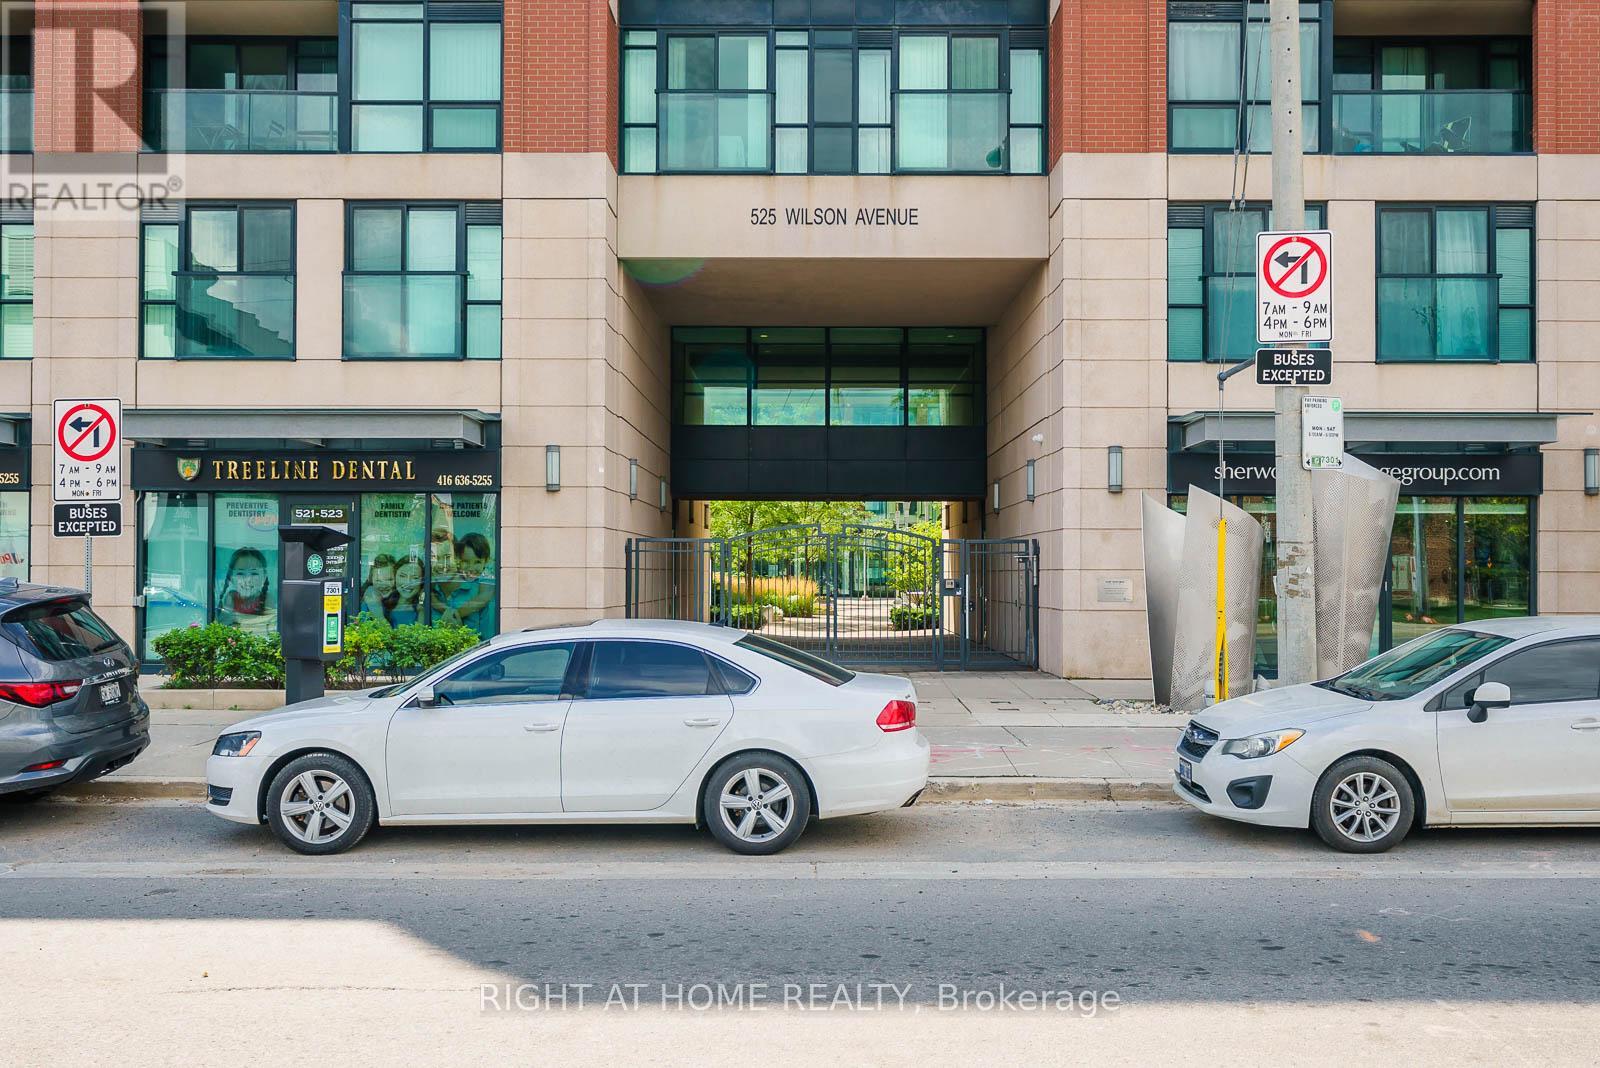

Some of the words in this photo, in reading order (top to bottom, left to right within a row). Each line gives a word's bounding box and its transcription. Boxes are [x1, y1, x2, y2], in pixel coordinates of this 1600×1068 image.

[750, 208, 777, 225] 525
[785, 208, 847, 225] WILSON
[855, 208, 919, 225] AVENUE
[1273, 353, 1315, 366] BUSES
[1262, 369, 1326, 381] EXCEPTED
[59, 464, 65, 474] 7
[69, 466, 80, 474] AM
[96, 463, 102, 473] 9
[105, 465, 116, 473] AM
[212, 460, 320, 480] TREELINE
[332, 460, 417, 480] DENTAL
[0, 473, 20, 484] 5255
[59, 478, 66, 487] 4
[96, 478, 103, 487] 6
[106, 479, 117, 487] PM
[436, 474, 453, 486] 416
[454, 474, 493, 486] 636-5255
[380, 502, 405, 510] FAMILY
[456, 502, 488, 510] PATIENTS
[69, 507, 108, 519] BUSES
[295, 509, 344, 518] 521-523
[374, 510, 411, 518] DENTISTRY
[58, 521, 117, 533] EXCEPTED
